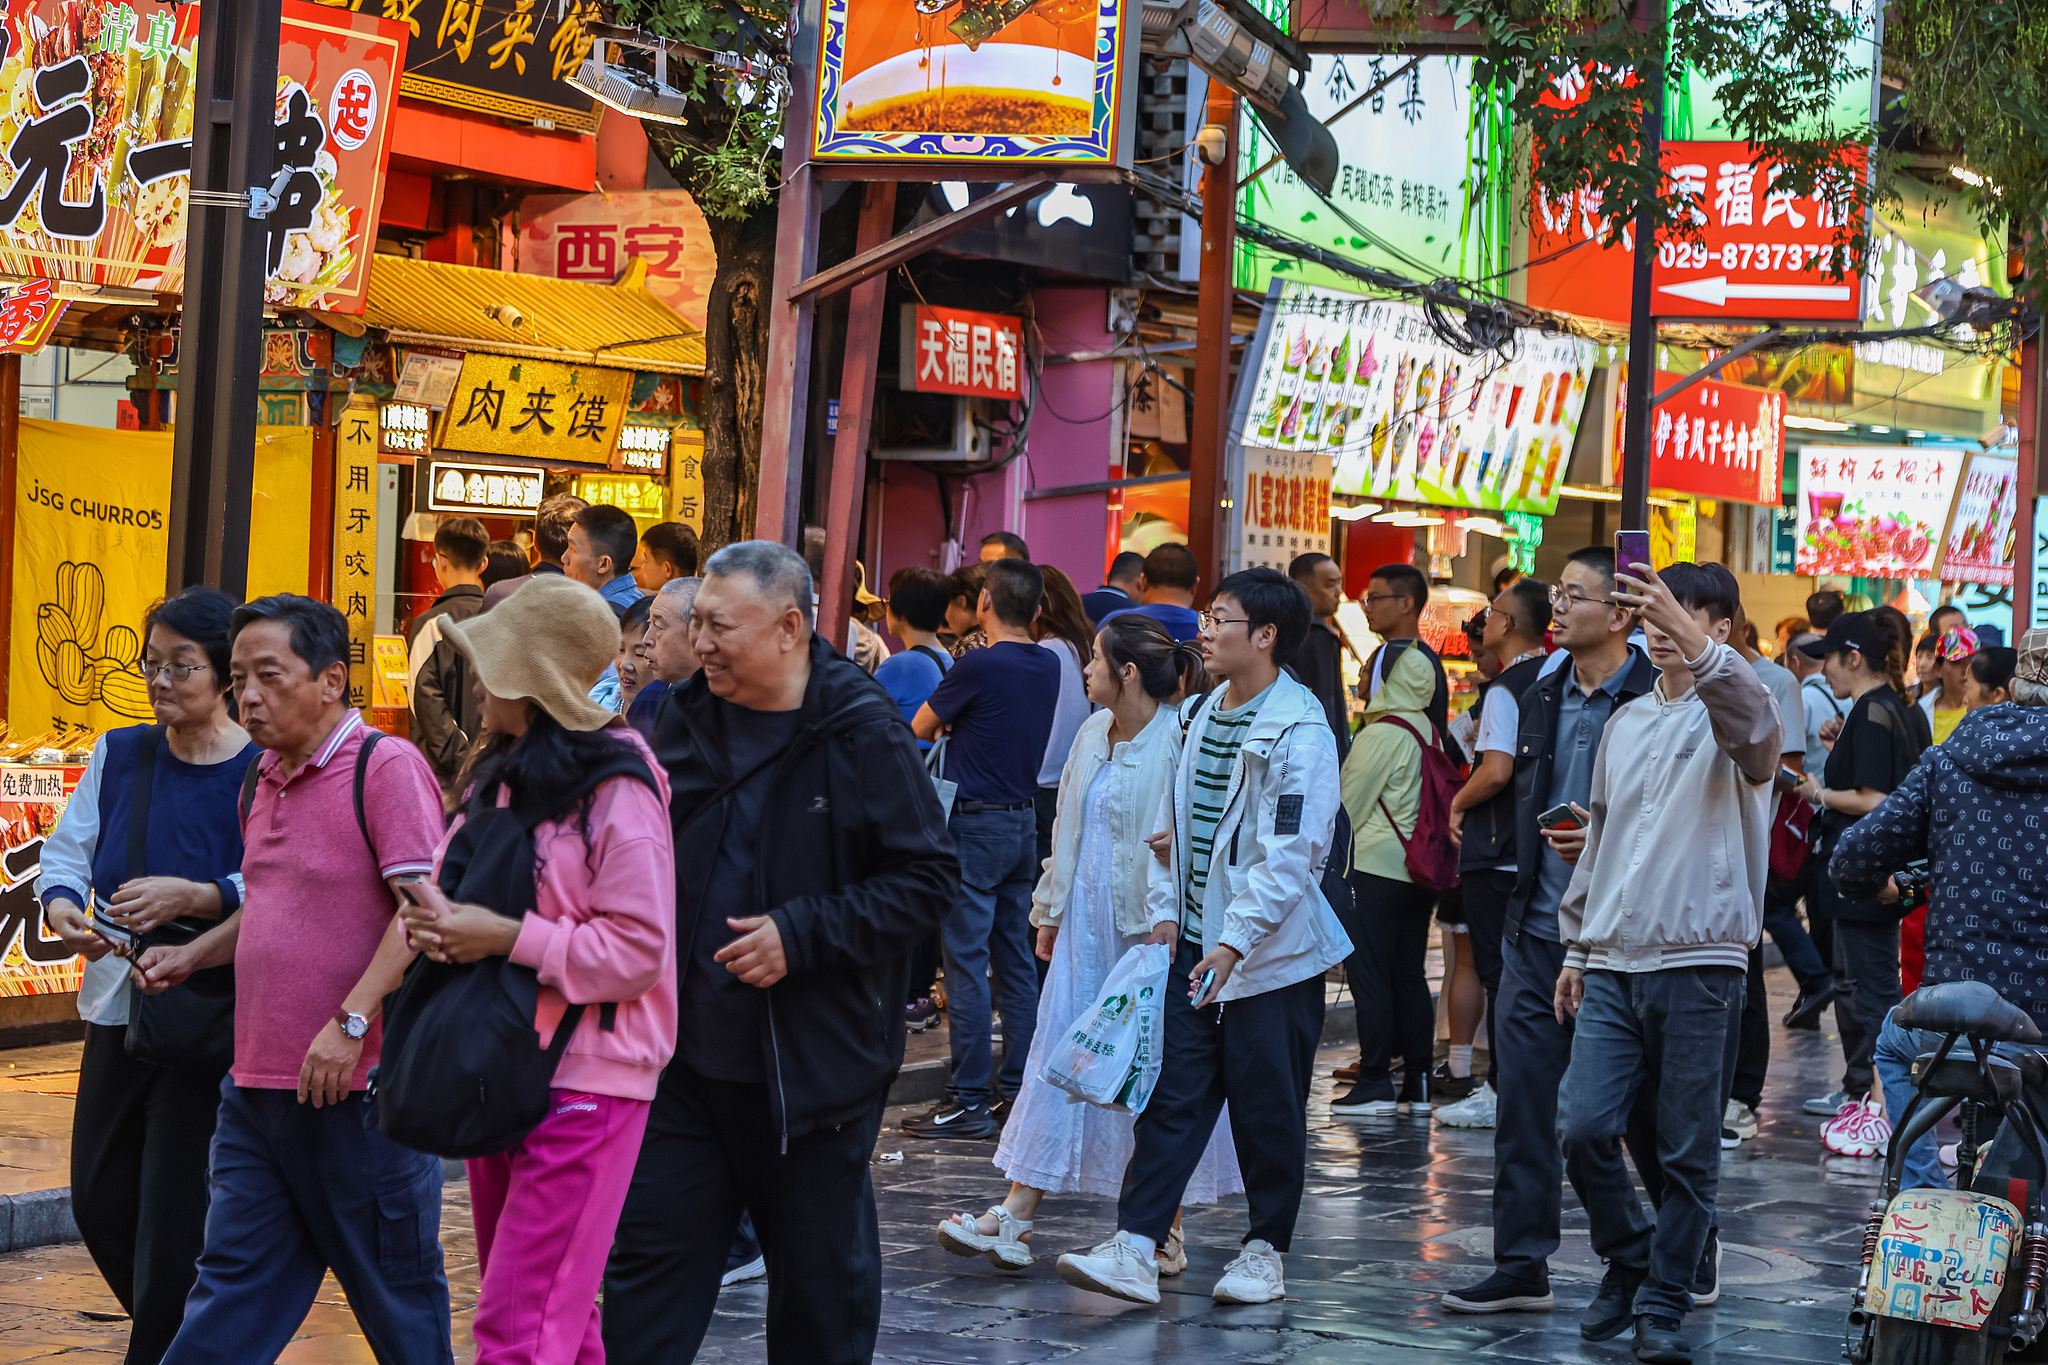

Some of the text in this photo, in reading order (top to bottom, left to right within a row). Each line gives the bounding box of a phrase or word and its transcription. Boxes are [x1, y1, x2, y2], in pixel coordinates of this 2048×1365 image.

[101, 1, 177, 63] 清真
[334, 79, 371, 141] 起
[1400, 178, 1450, 225] 鲜榨果汁
[556, 223, 685, 281] 西安
[920, 318, 1018, 393] 天福民宿
[456, 381, 611, 442] 肉夹馍
[1809, 456, 1946, 486] 鲜榨石榴汁
[70, 498, 163, 530] CHURROS
[2, 772, 62, 798] 免费加热
